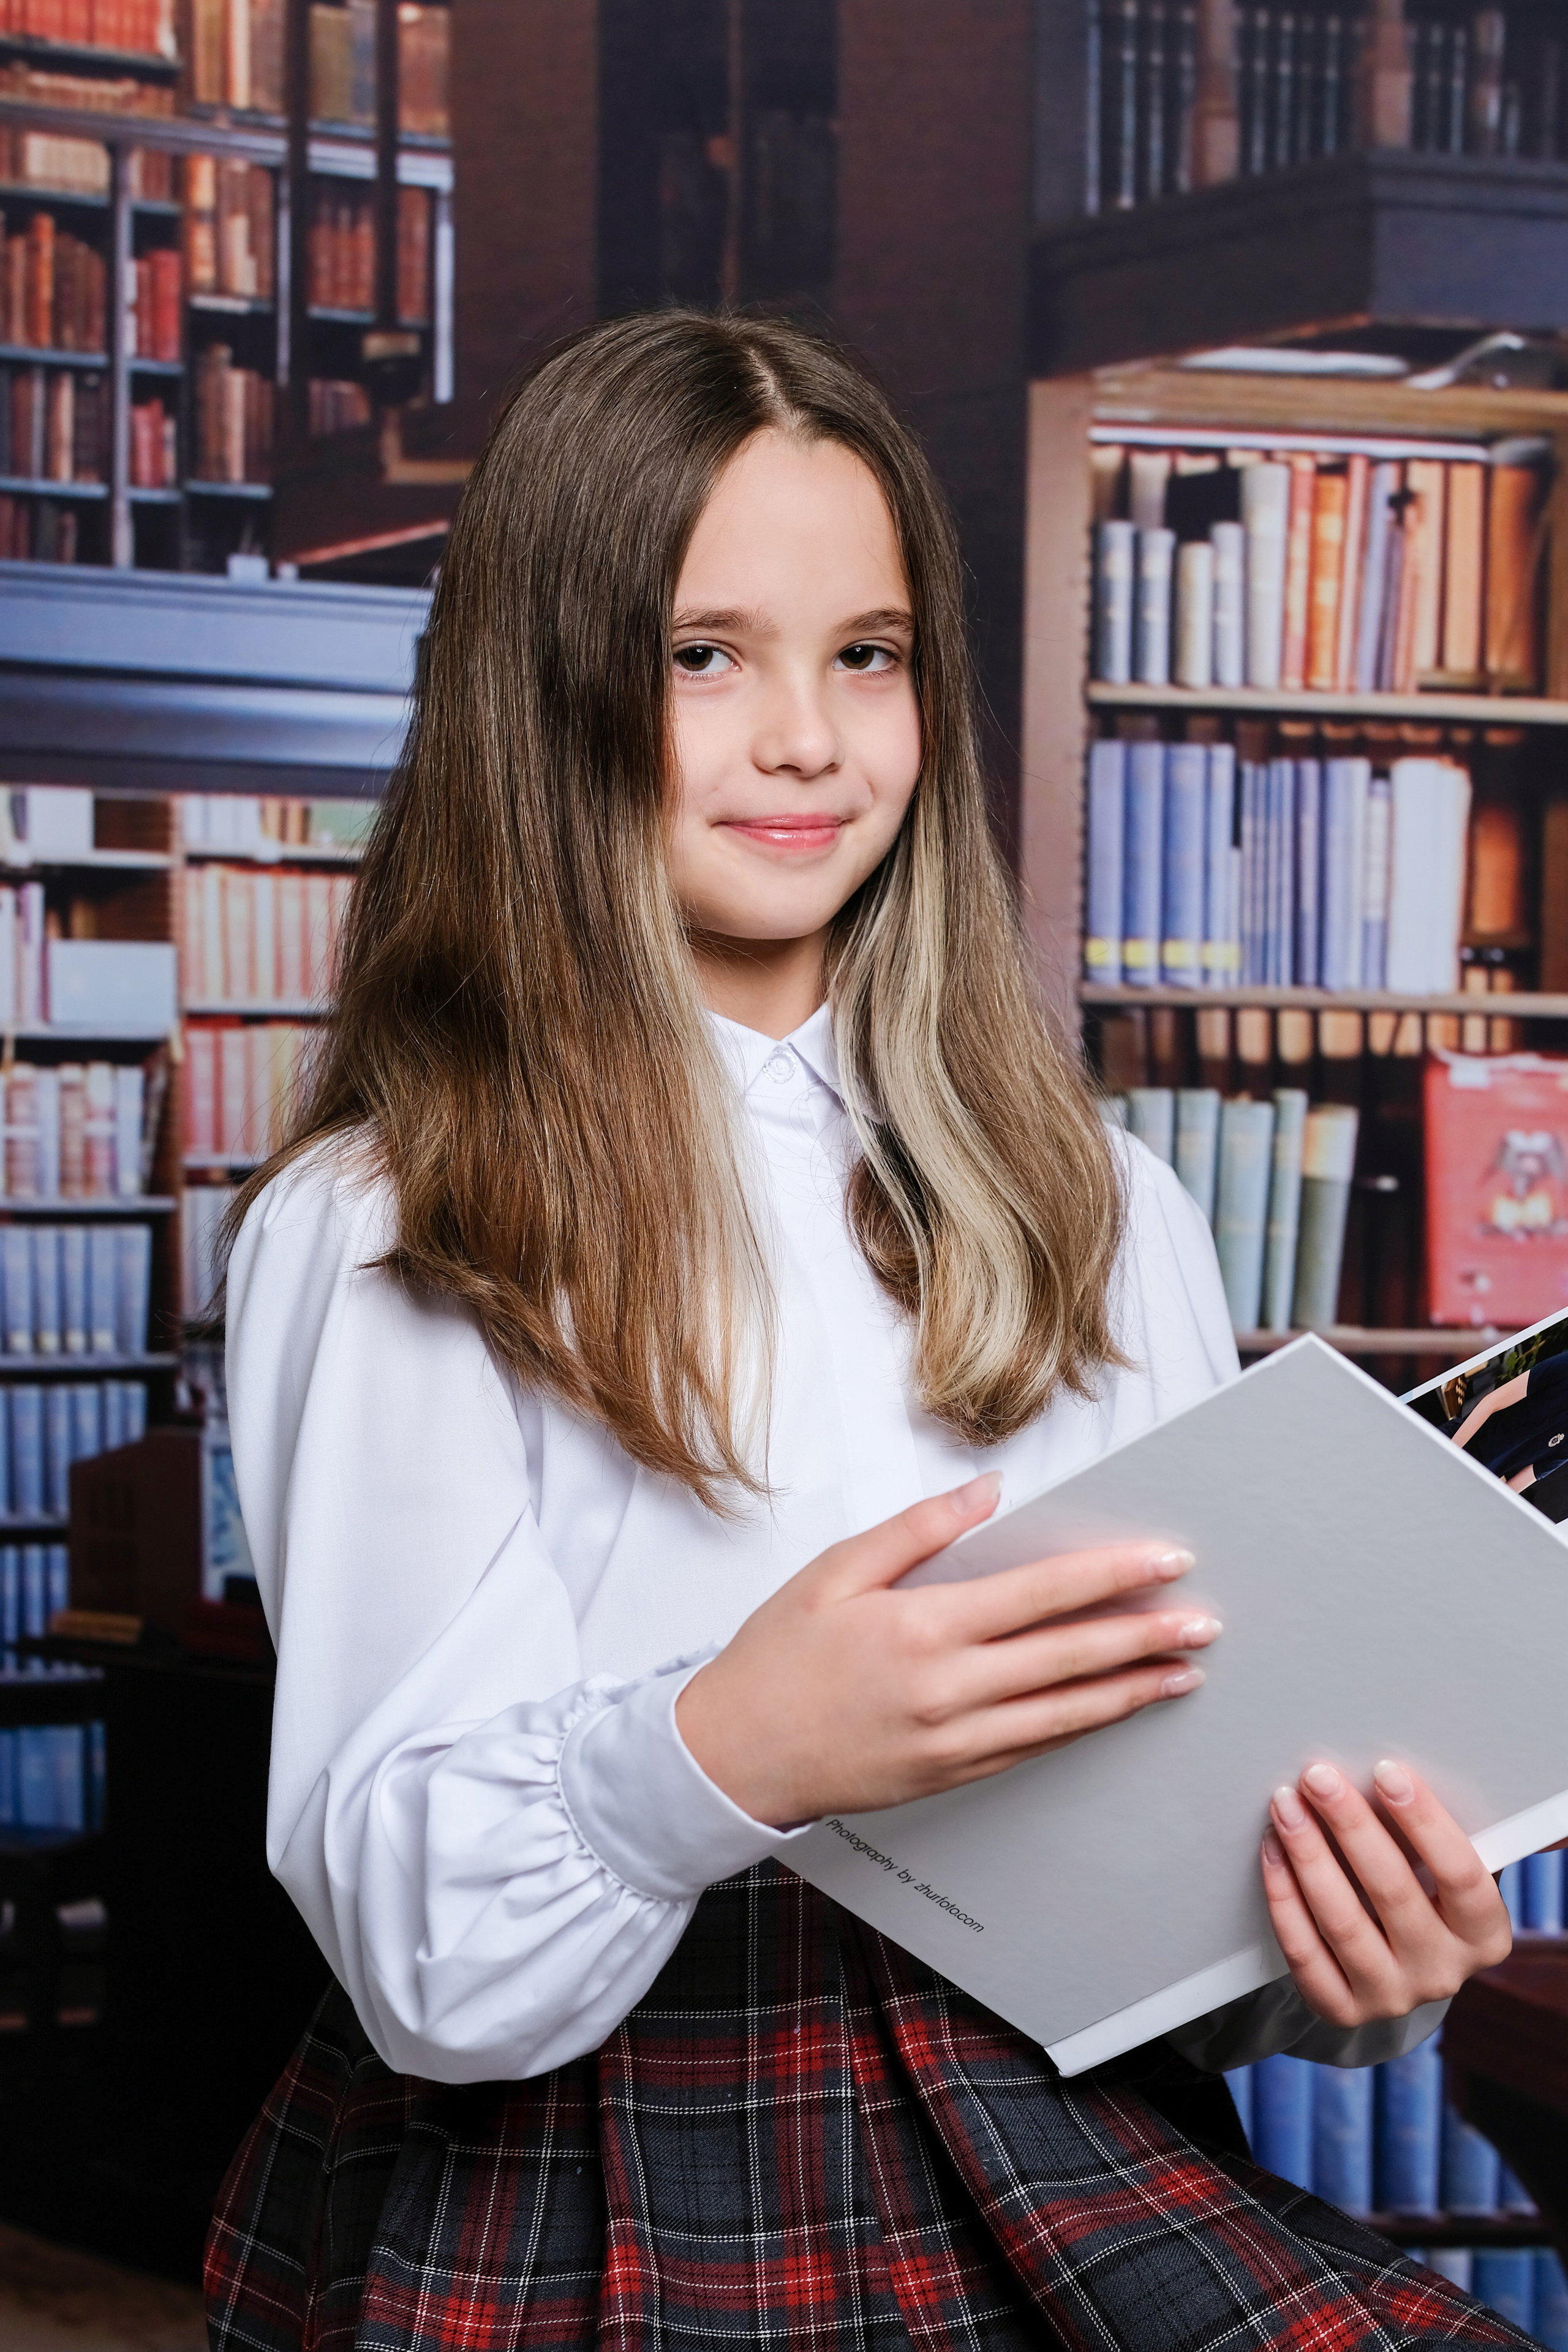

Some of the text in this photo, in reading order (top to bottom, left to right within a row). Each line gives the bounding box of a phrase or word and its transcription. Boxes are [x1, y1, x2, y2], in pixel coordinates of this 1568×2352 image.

[826, 1819, 984, 1933] Photography by zhurfoto.com
